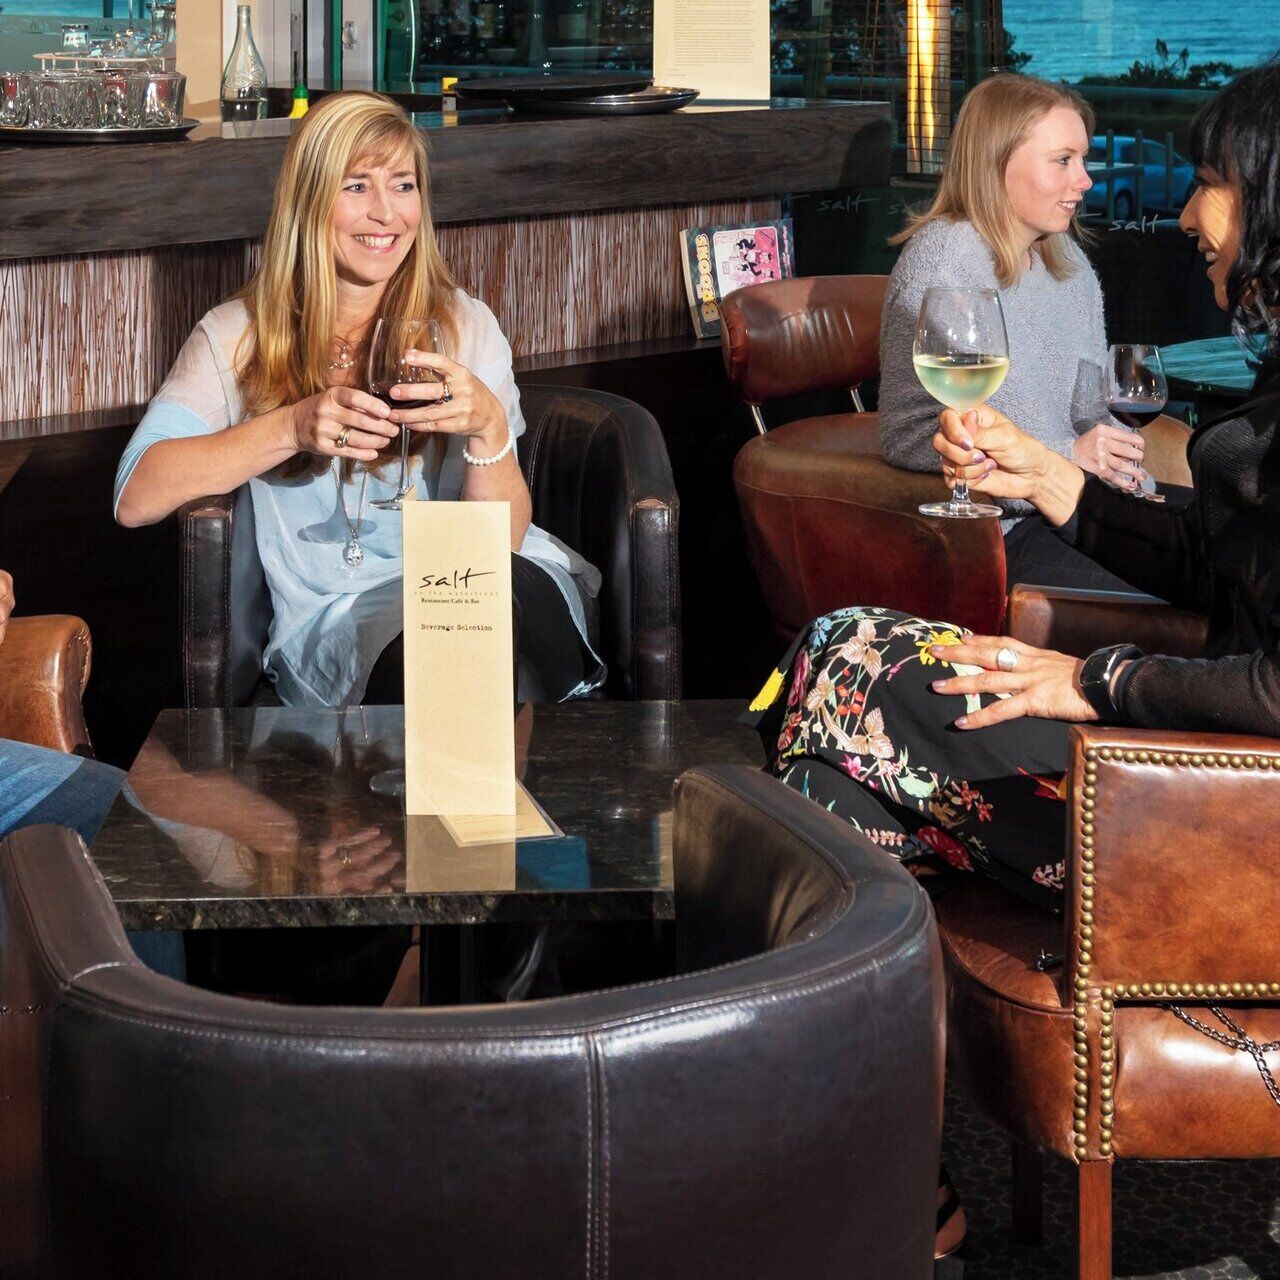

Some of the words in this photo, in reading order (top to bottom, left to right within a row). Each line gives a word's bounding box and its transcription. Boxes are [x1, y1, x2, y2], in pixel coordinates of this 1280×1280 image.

[817, 193, 881, 212] salt
[1108, 214, 1181, 234] salt
[419, 567, 497, 589] salt
[421, 623, 455, 632] Beverage
